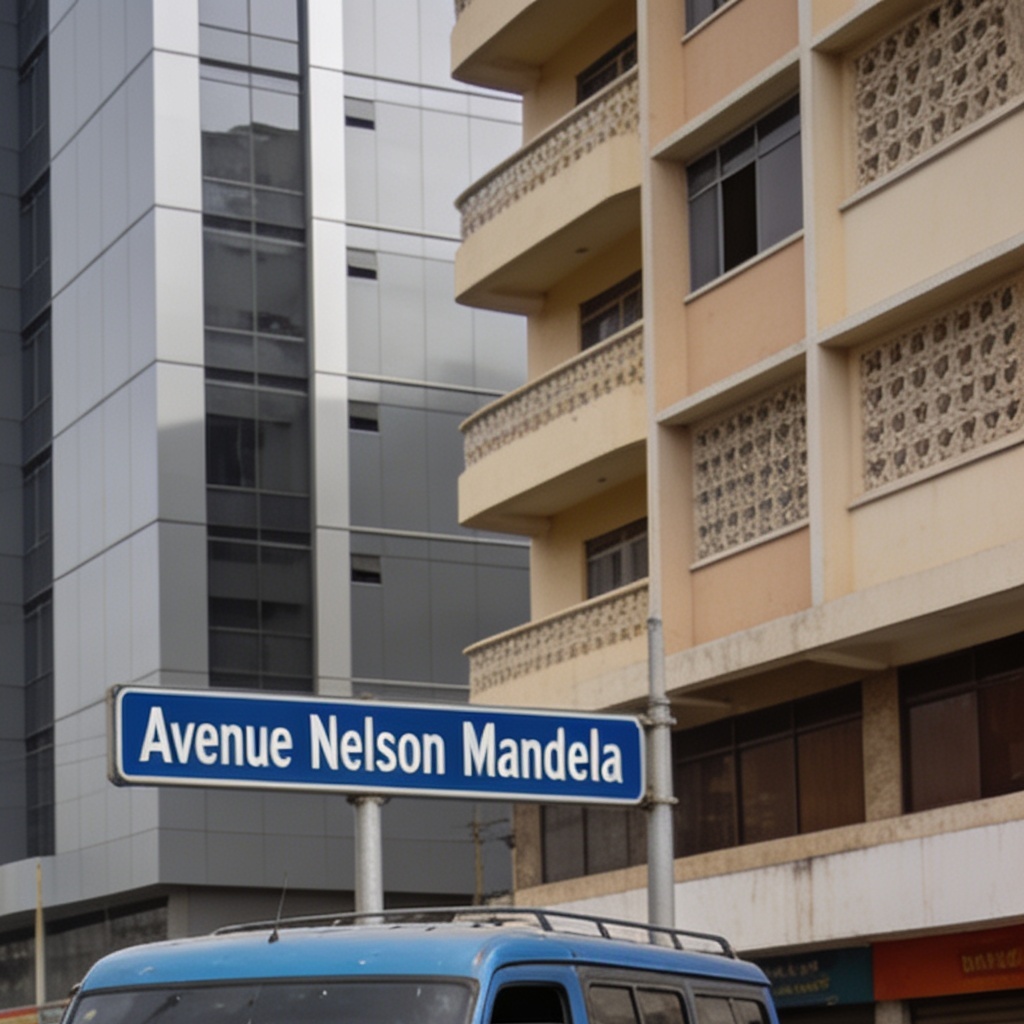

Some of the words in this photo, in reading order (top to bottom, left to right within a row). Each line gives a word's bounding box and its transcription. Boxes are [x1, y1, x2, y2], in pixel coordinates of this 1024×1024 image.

[139, 706, 293, 767] Avenue
[309, 713, 445, 775] Nelson
[463, 721, 623, 784] Mandela
